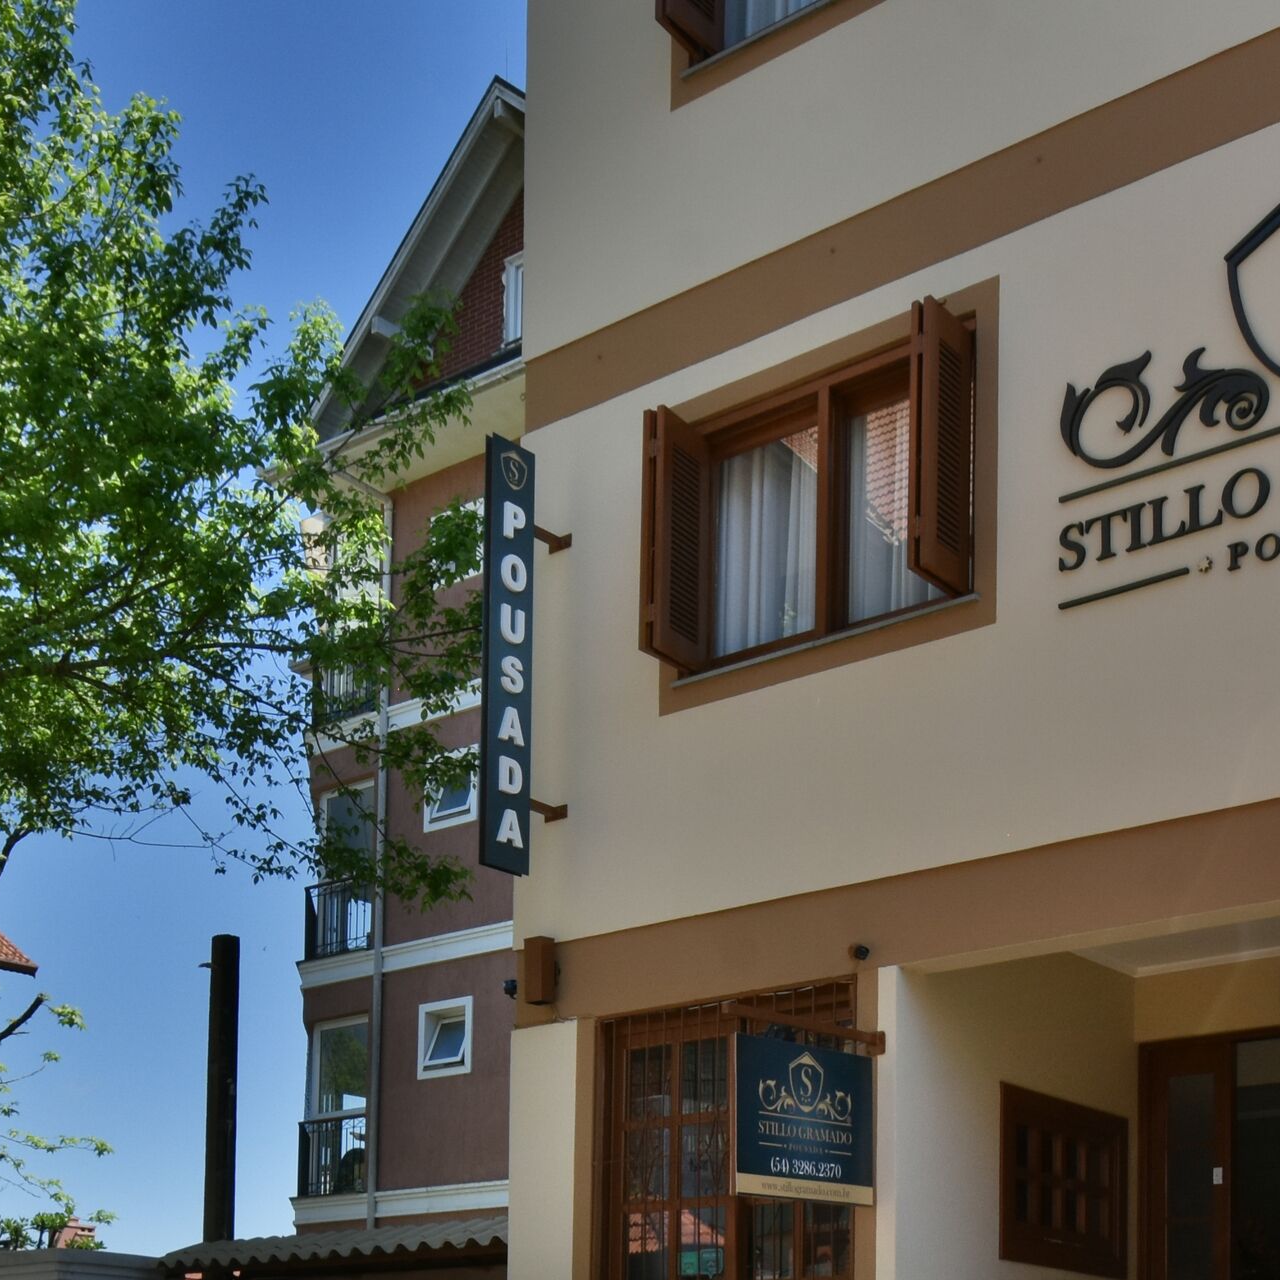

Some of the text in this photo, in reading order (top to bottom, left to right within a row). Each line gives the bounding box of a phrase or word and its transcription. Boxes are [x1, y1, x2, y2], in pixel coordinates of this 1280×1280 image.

[1058, 467, 1271, 572] STILLO
[496, 500, 527, 849] POUSADA
[800, 1066, 812, 1097] S
[758, 1120, 852, 1145] STILLO GRAMADO
[770, 1156, 842, 1179] (54) 3286.2370
